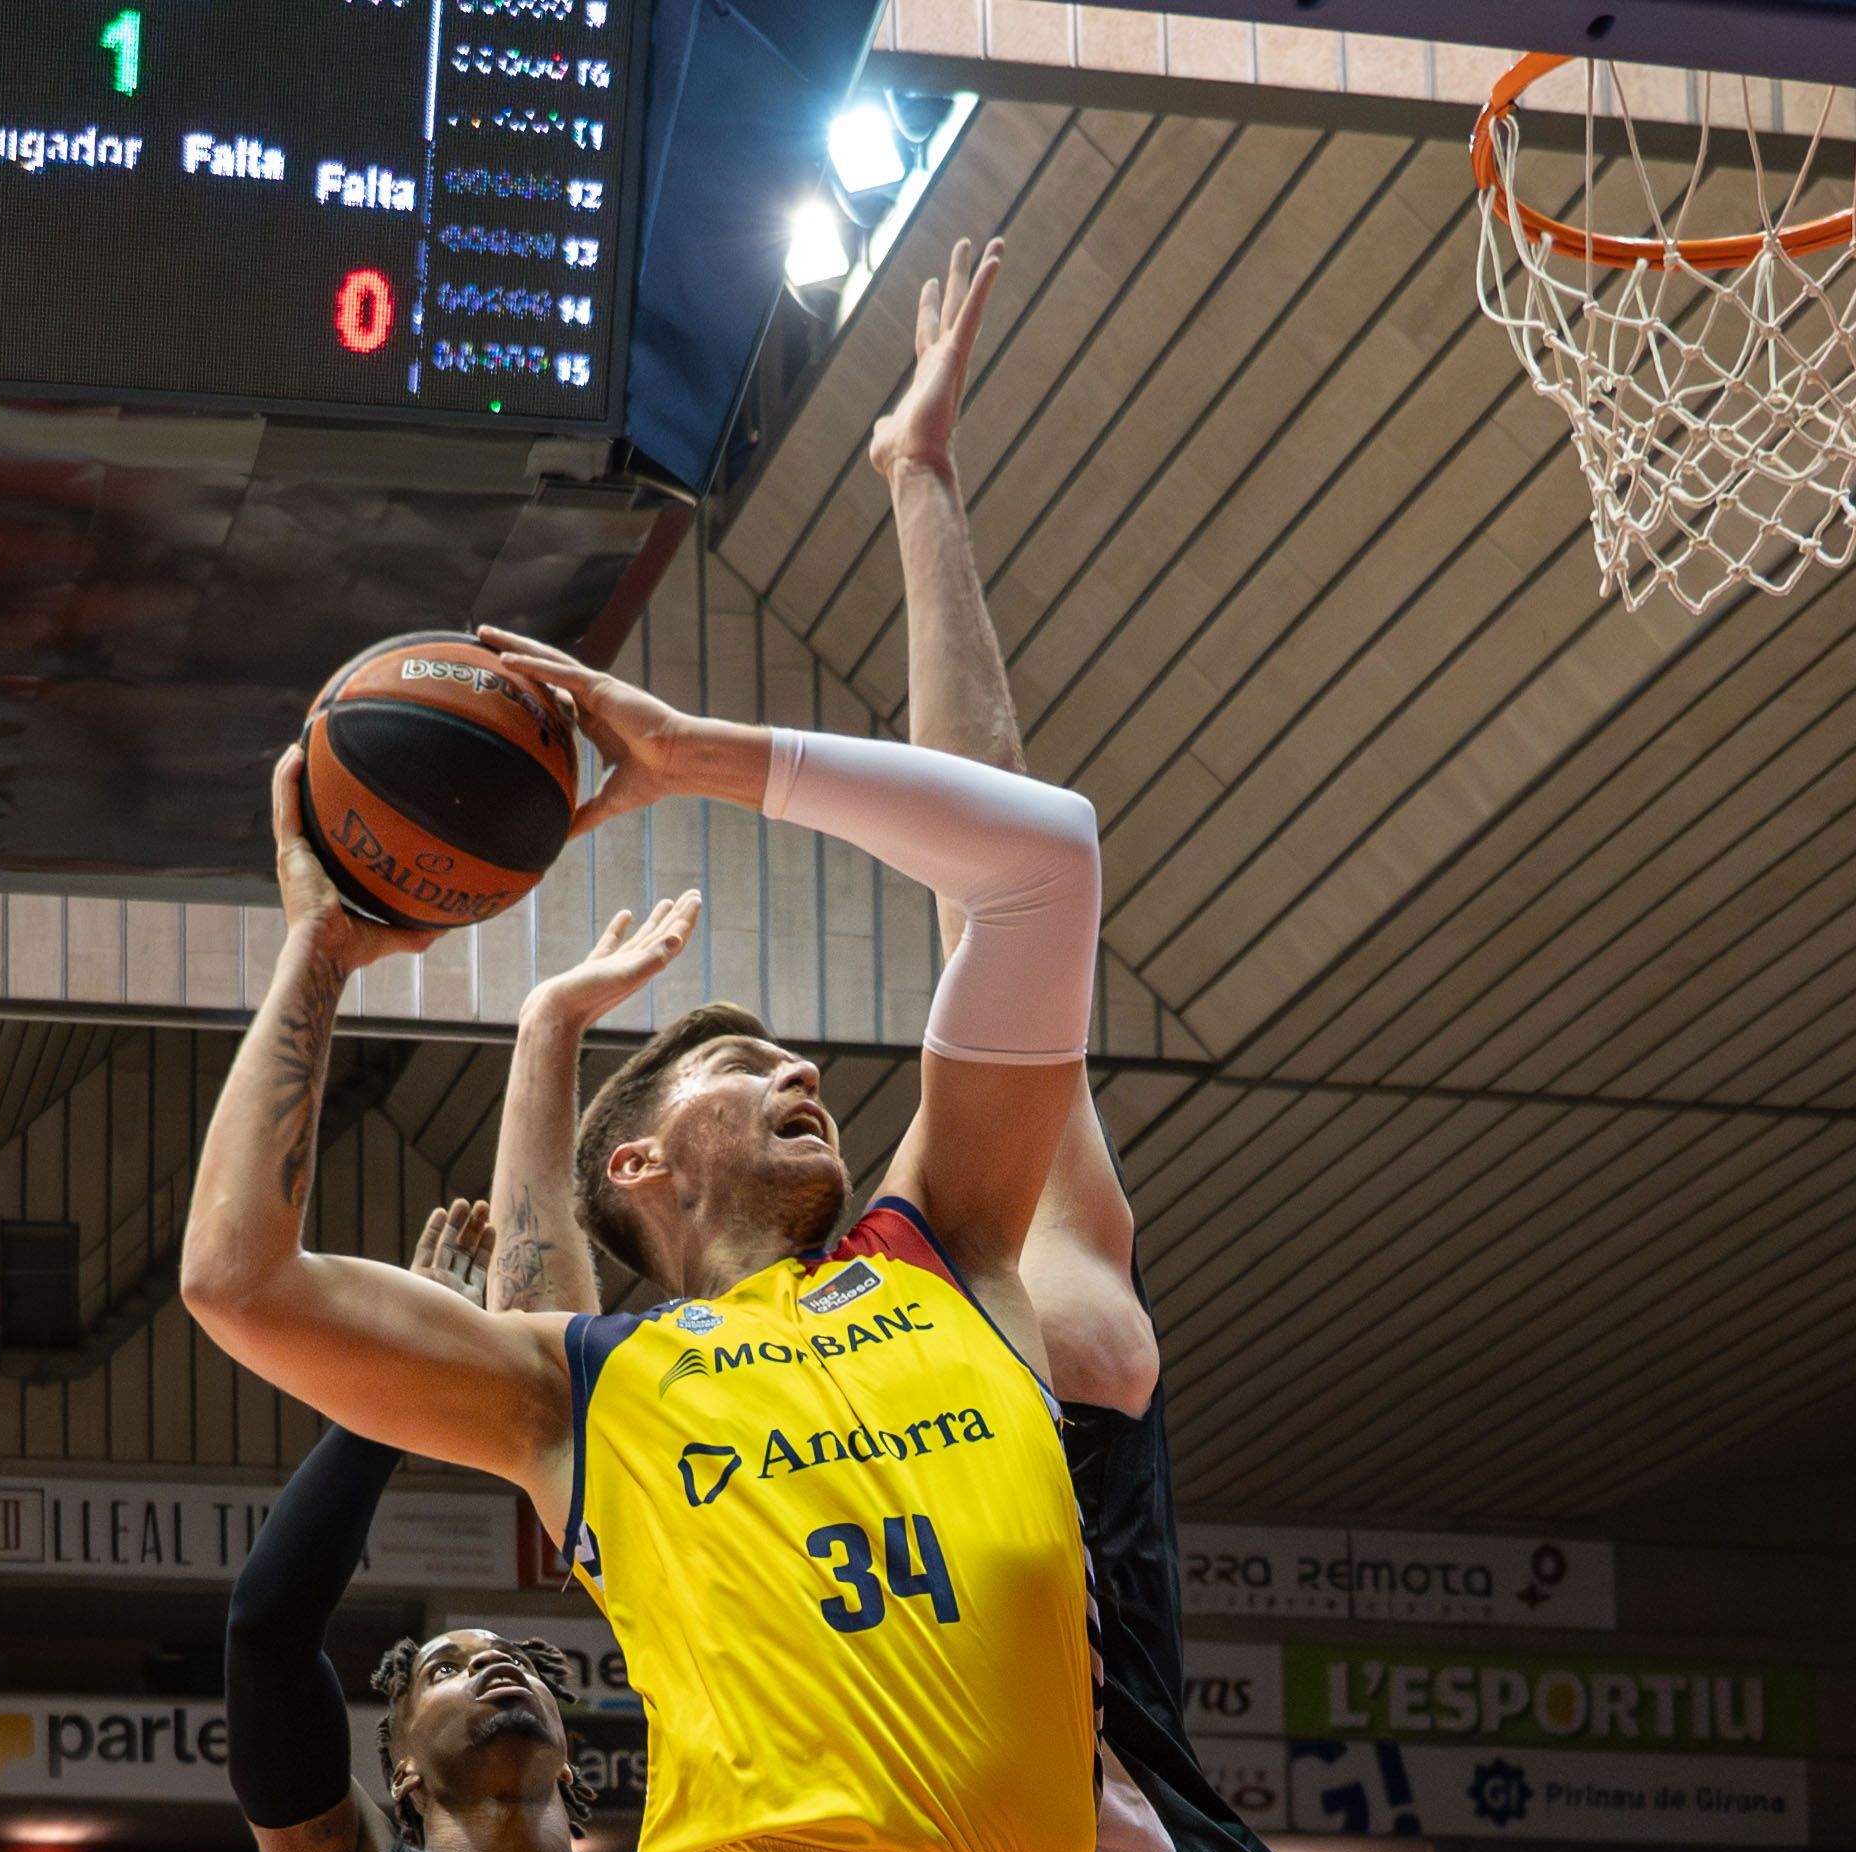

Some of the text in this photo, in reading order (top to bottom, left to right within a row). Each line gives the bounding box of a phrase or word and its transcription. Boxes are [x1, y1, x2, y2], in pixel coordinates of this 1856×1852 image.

[100, 9, 141, 97] 1
[182, 131, 285, 181] Falta
[315, 160, 416, 212] Falta
[336, 267, 394, 354] 0
[816, 1277, 877, 1314] endesa
[714, 1303, 935, 1373] MOBANC
[756, 1406, 995, 1479] Andorra
[53, 1500, 191, 1566] LLEAL
[806, 1513, 960, 1635] 34
[1327, 1660, 1765, 1742] L'ESPORTIU
[48, 1706, 227, 1779] parle
